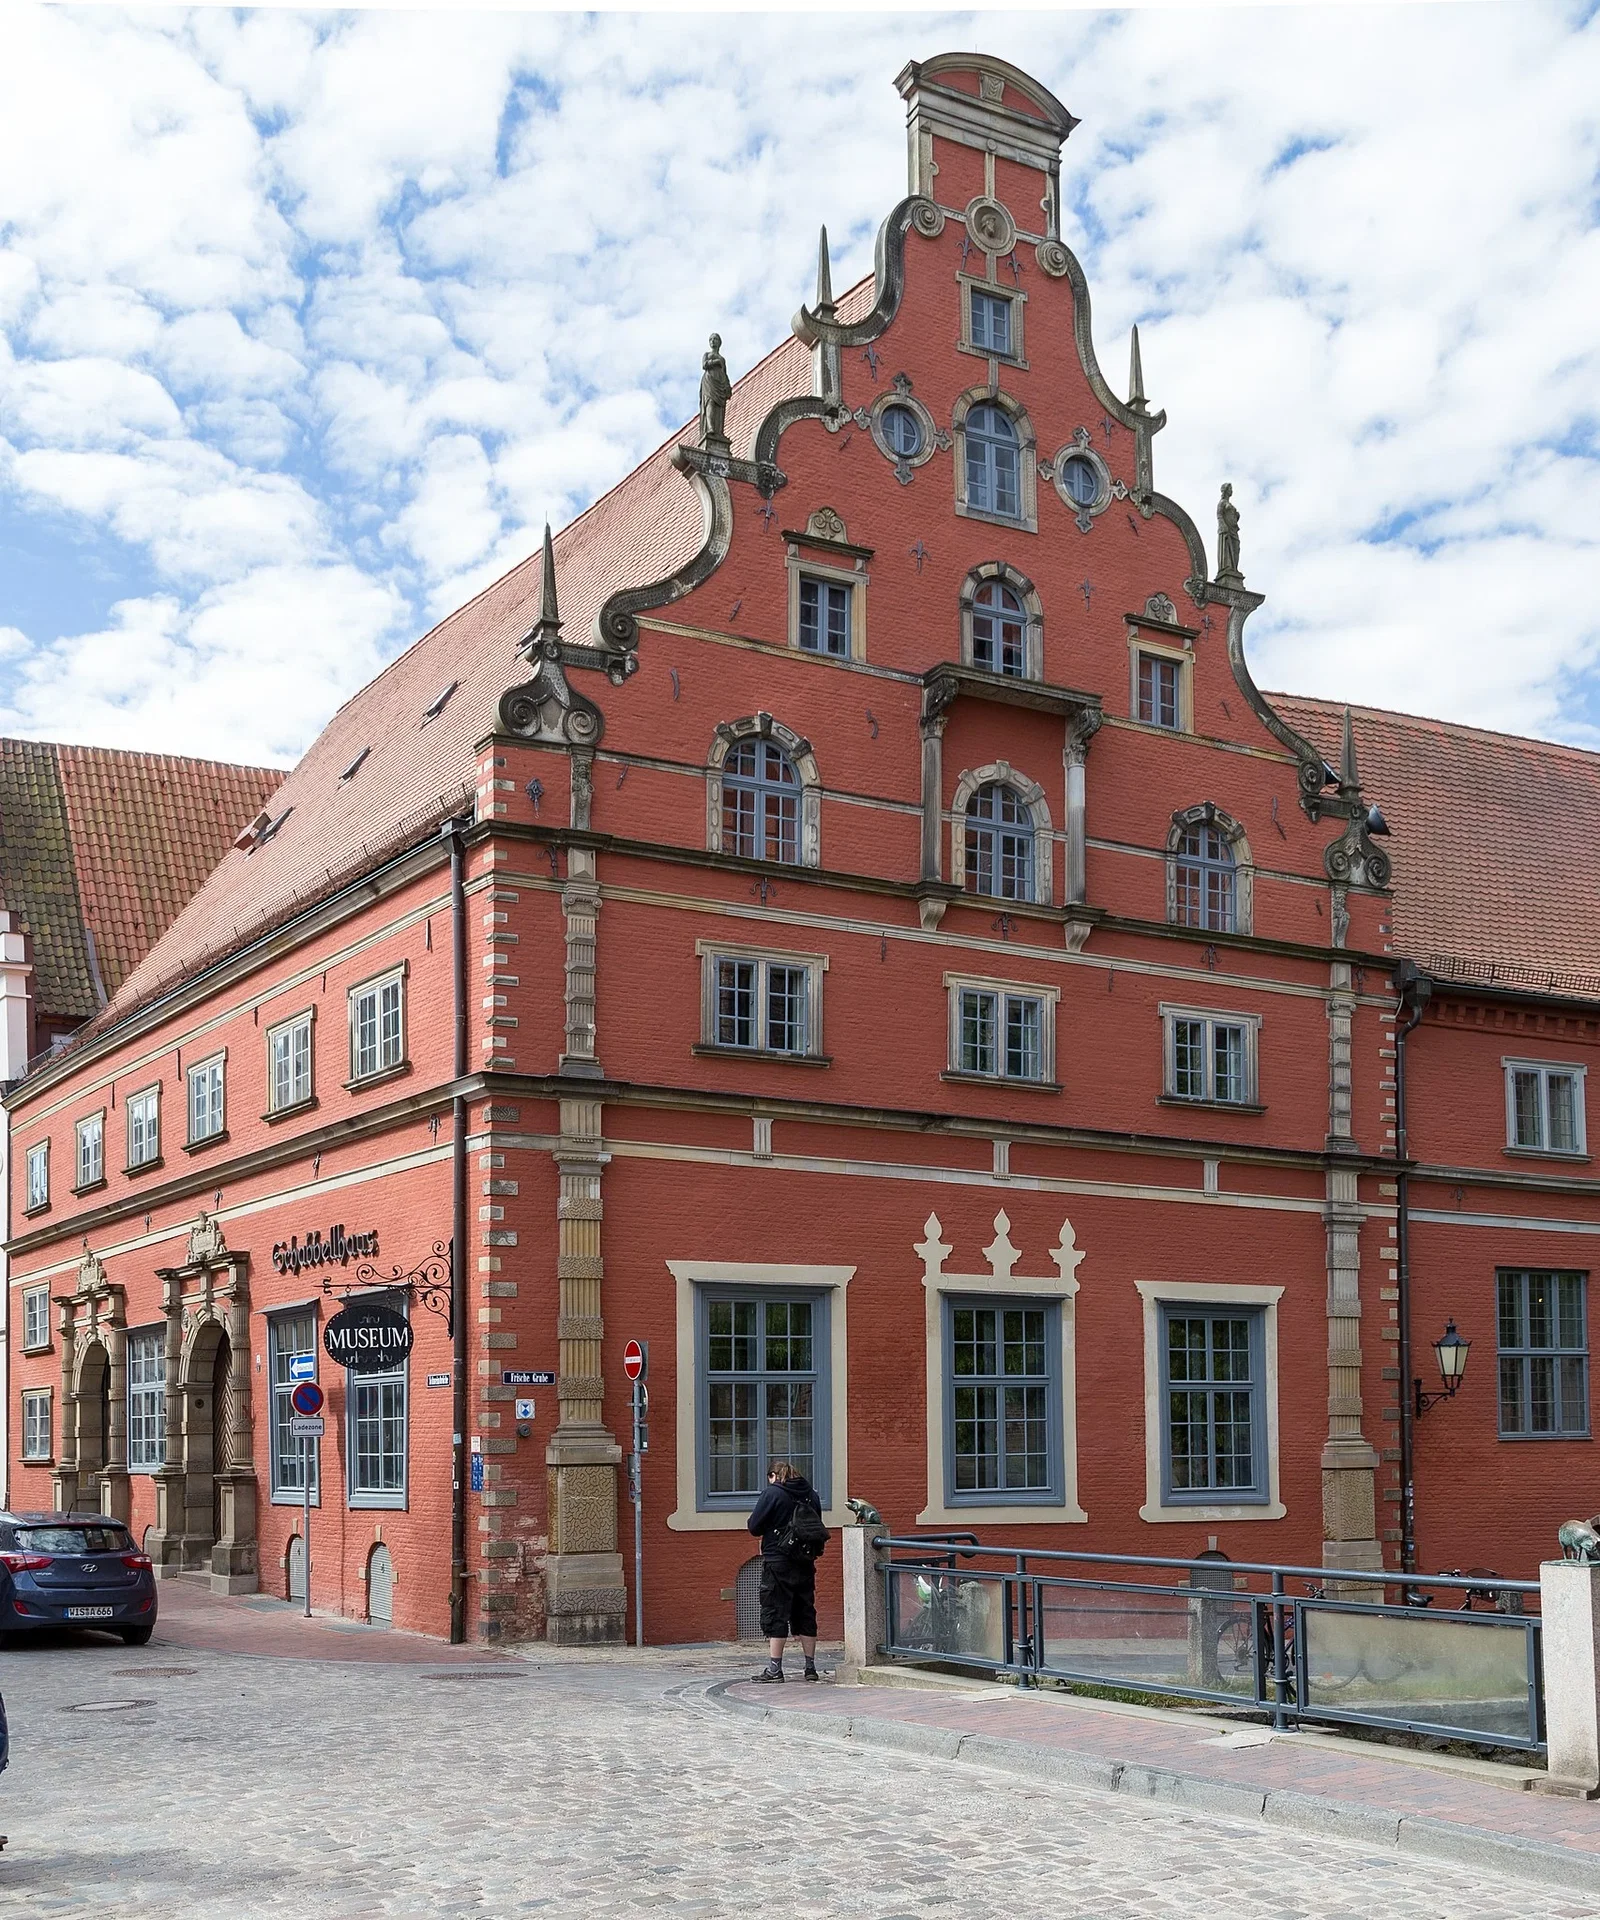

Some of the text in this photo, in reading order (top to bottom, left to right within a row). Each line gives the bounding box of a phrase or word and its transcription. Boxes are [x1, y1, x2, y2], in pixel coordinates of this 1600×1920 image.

[328, 1327, 408, 1350] MUSEUM
[510, 1372, 549, 1383] Frische Grube
[69, 1607, 85, 1616] WIS
[97, 1607, 112, 1616] 666
